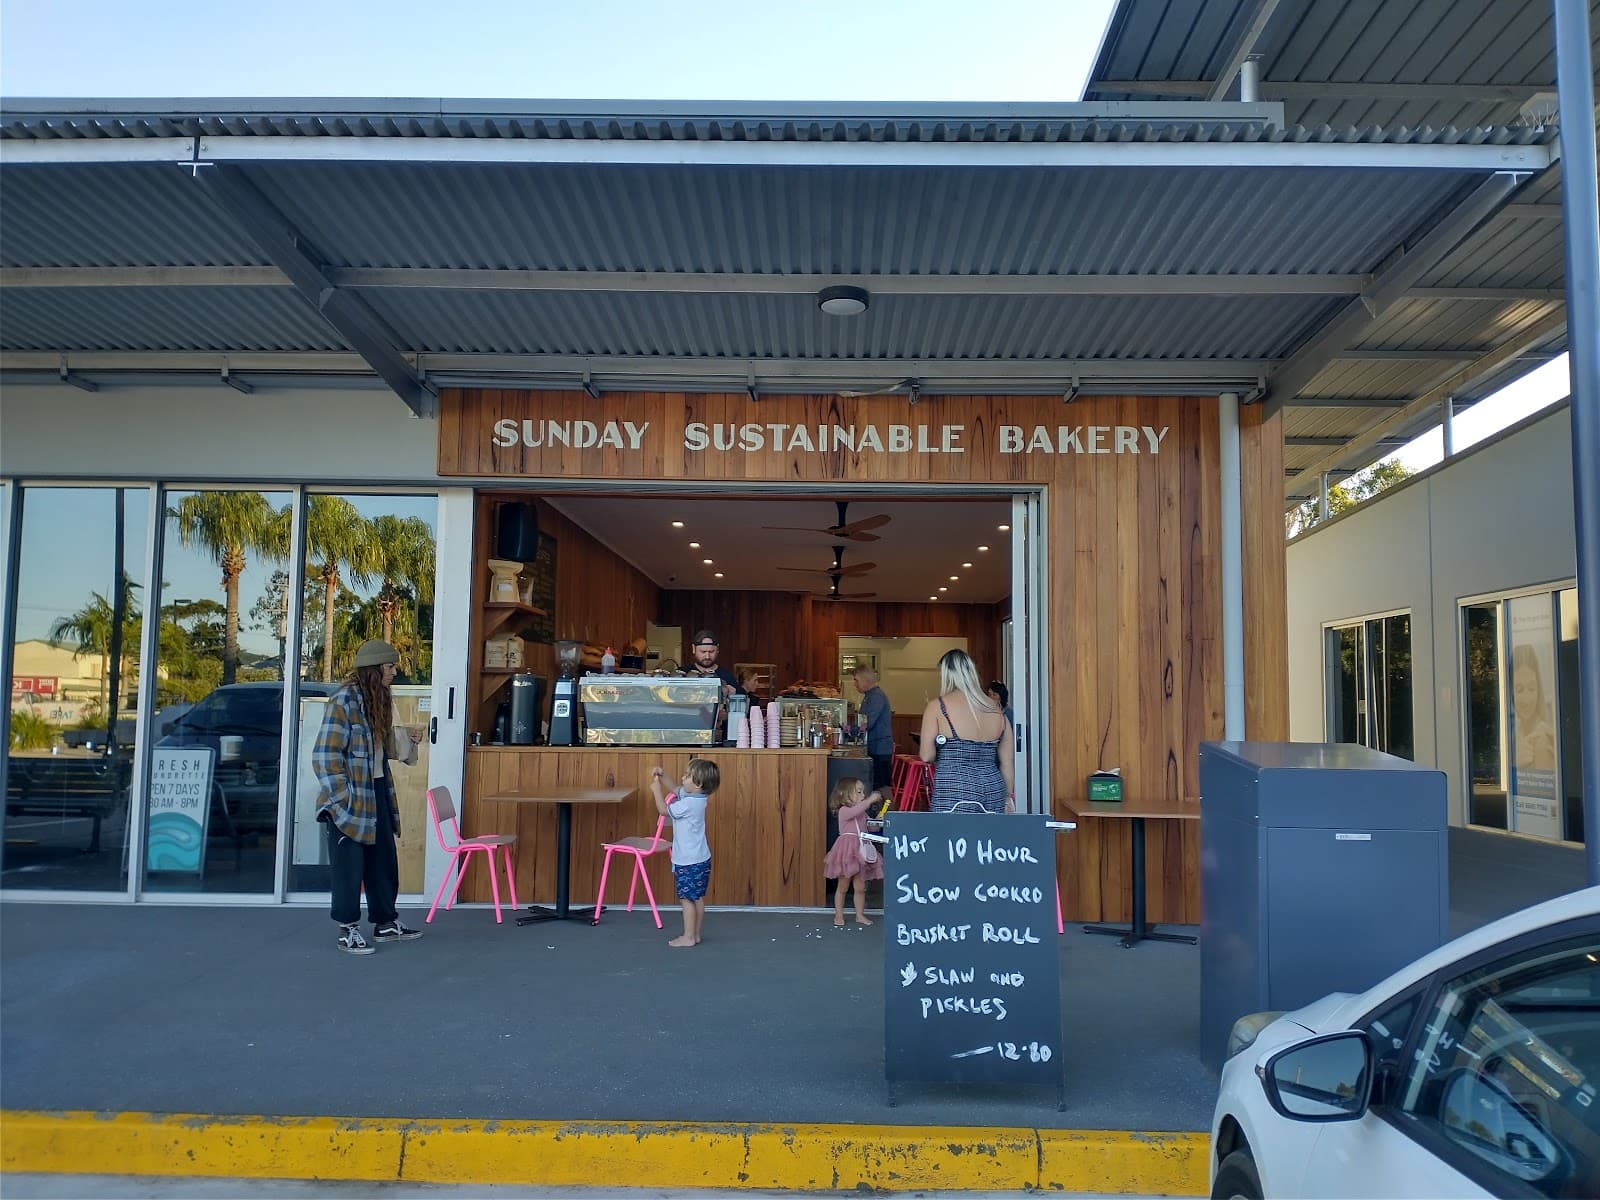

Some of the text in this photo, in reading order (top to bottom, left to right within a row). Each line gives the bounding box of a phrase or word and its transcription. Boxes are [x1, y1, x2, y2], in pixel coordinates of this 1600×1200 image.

[492, 418, 1169, 454] SUNDAY SUSTAINABLE BAKERY
[159, 759, 200, 771] RESH
[176, 783, 200, 795] DAYS
[948, 837, 968, 865] 10
[977, 838, 1039, 866] HOUR
[895, 873, 961, 905] SLOW
[982, 922, 1041, 945] ROLL
[924, 966, 976, 987] SLAW
[919, 994, 1009, 1021] PICKLES
